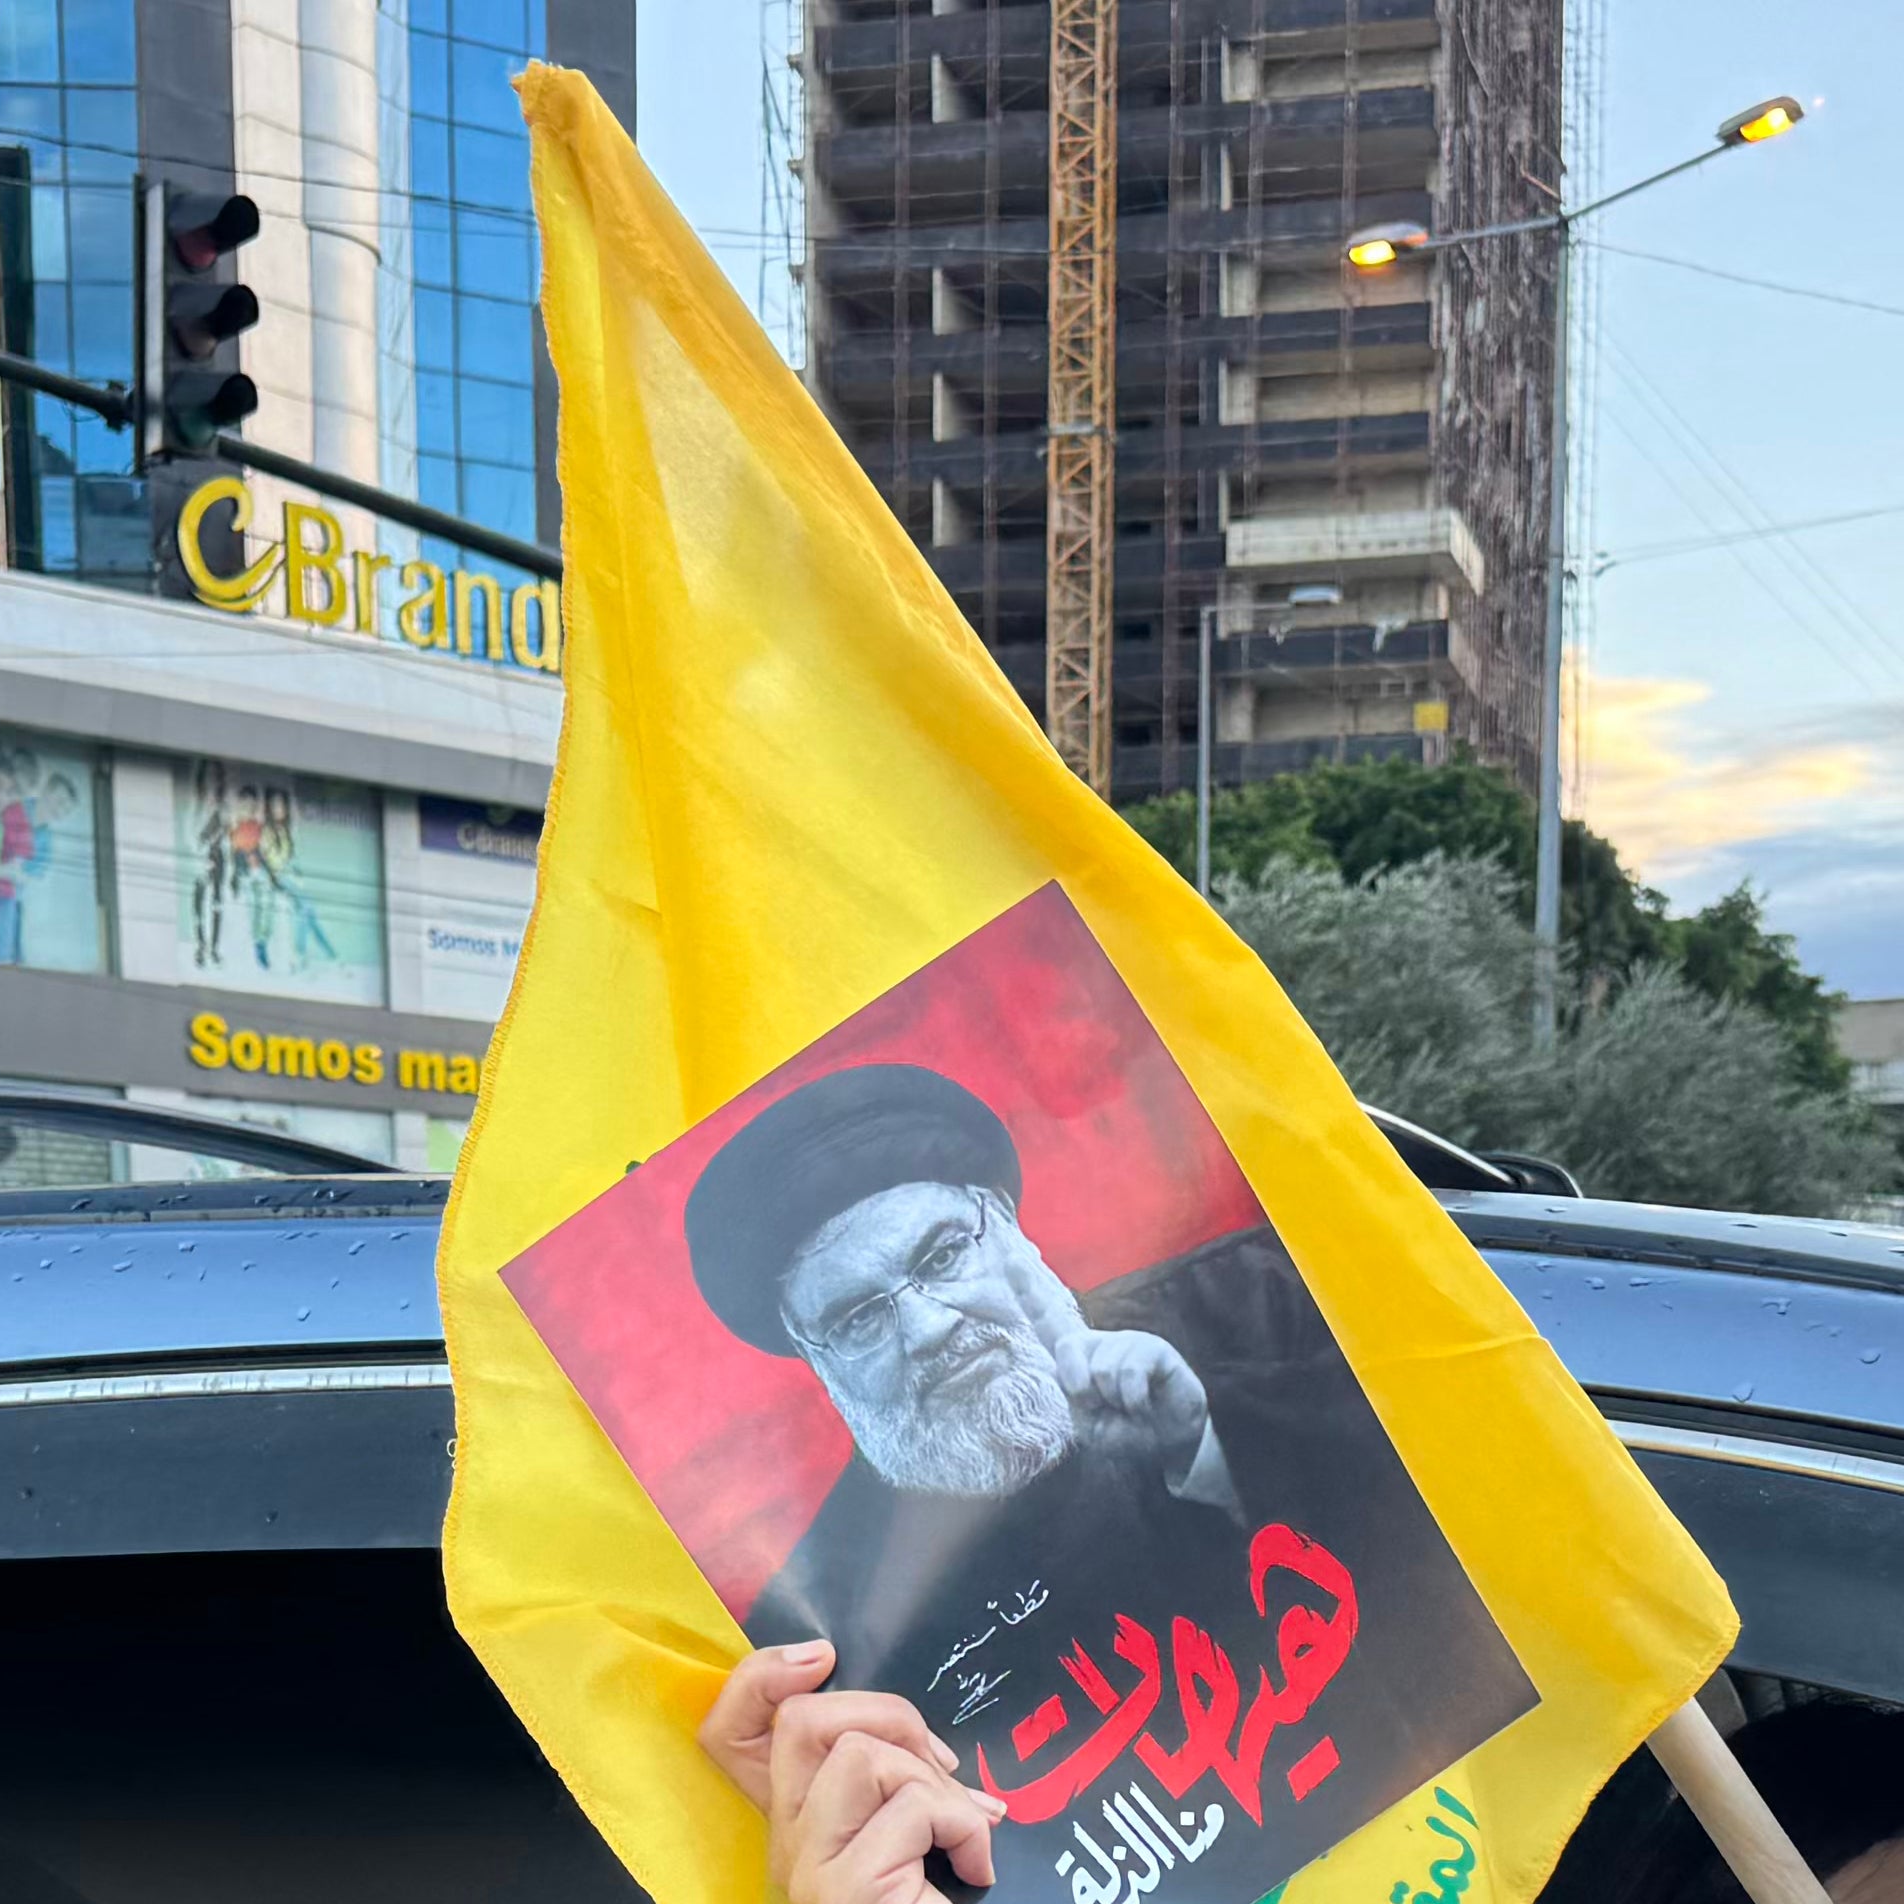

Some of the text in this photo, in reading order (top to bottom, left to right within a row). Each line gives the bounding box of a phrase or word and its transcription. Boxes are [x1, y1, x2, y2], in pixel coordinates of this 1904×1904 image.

[427, 928, 496, 957] Somos
[190, 1011, 385, 1086] Somos
[976, 1522, 1360, 1827] هيهات
[1129, 1780, 1225, 1863] منا
